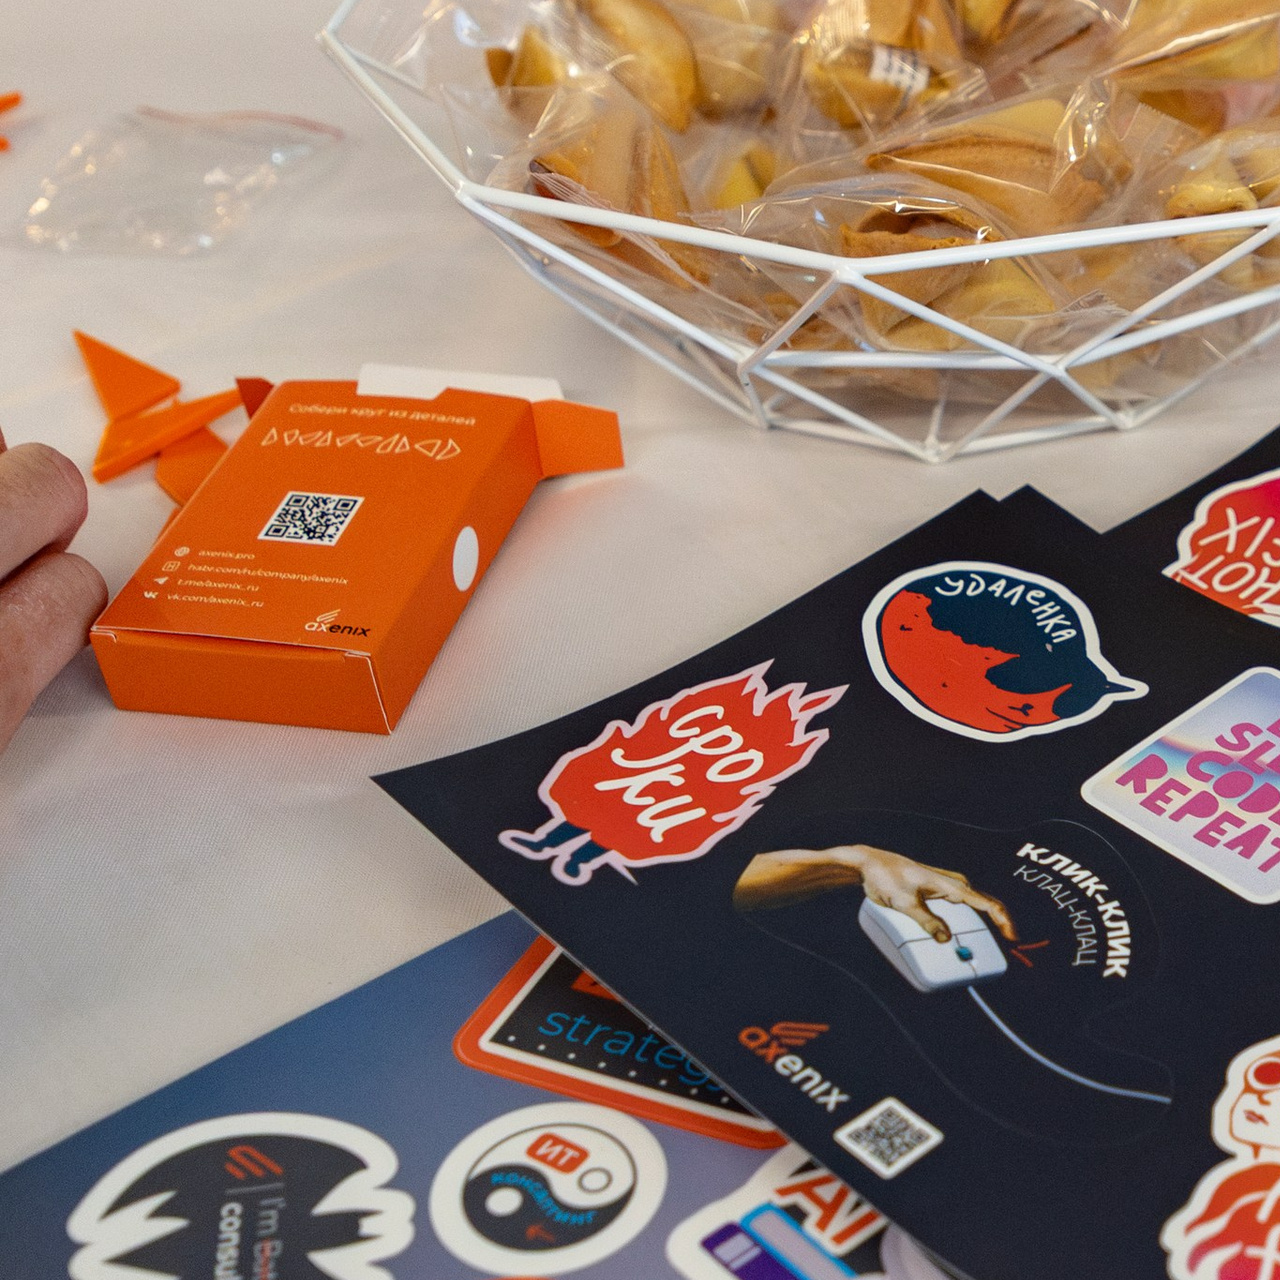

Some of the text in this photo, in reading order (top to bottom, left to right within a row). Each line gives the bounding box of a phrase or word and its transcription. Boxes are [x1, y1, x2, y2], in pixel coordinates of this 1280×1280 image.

[198, 550, 255, 561] axenix.pro
[304, 620, 371, 638] axenix
[1014, 864, 1097, 966] КЛАЦ-КЛАЦ
[1016, 842, 1131, 979] КЛИК-КЛИК
[539, 1009, 722, 1088] strateg
[739, 1025, 851, 1111] axenix
[535, 1141, 580, 1169] ИТ
